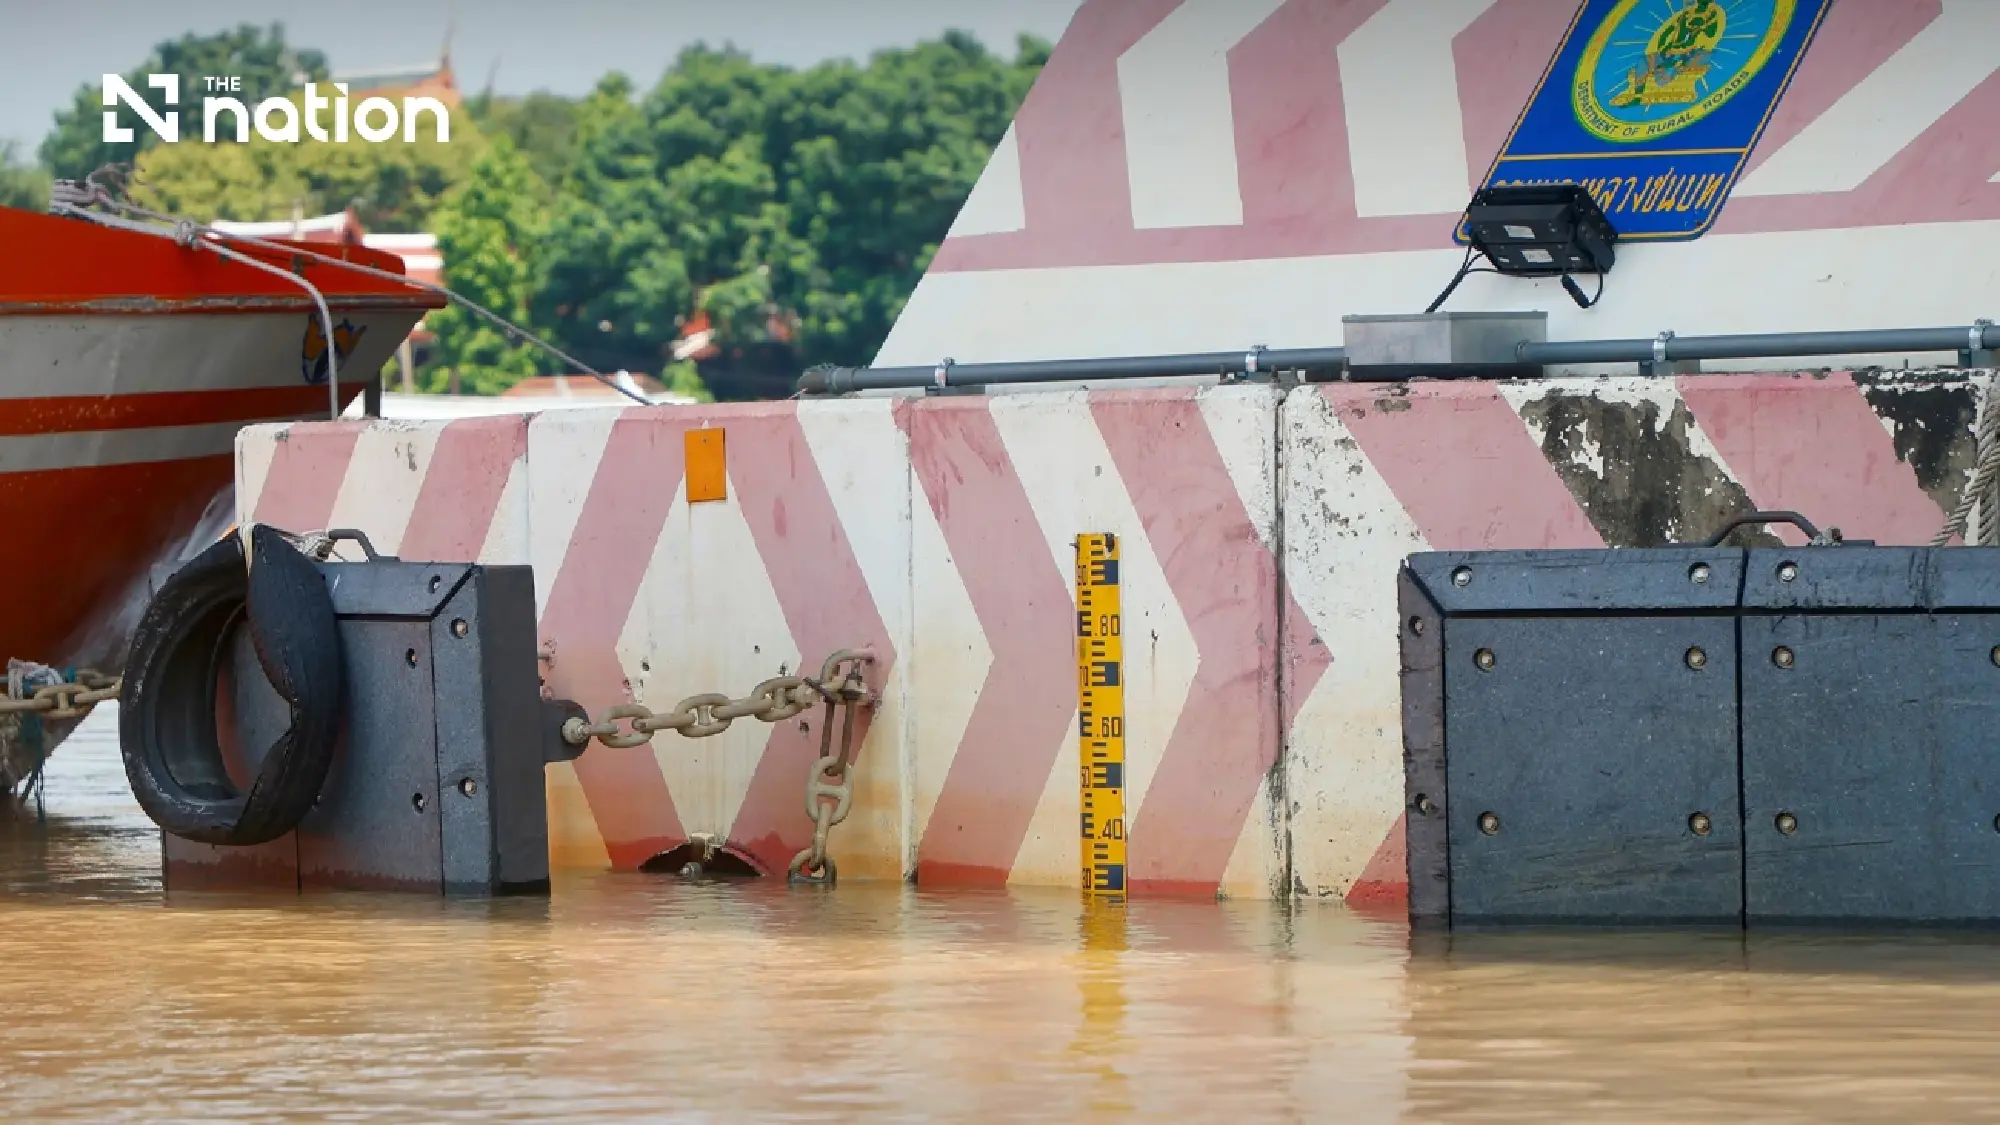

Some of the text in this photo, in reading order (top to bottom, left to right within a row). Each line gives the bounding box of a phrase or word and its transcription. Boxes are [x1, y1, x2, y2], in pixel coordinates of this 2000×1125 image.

[1577, 70, 1750, 137] DEPARTMENT OF RURAL ROADS
